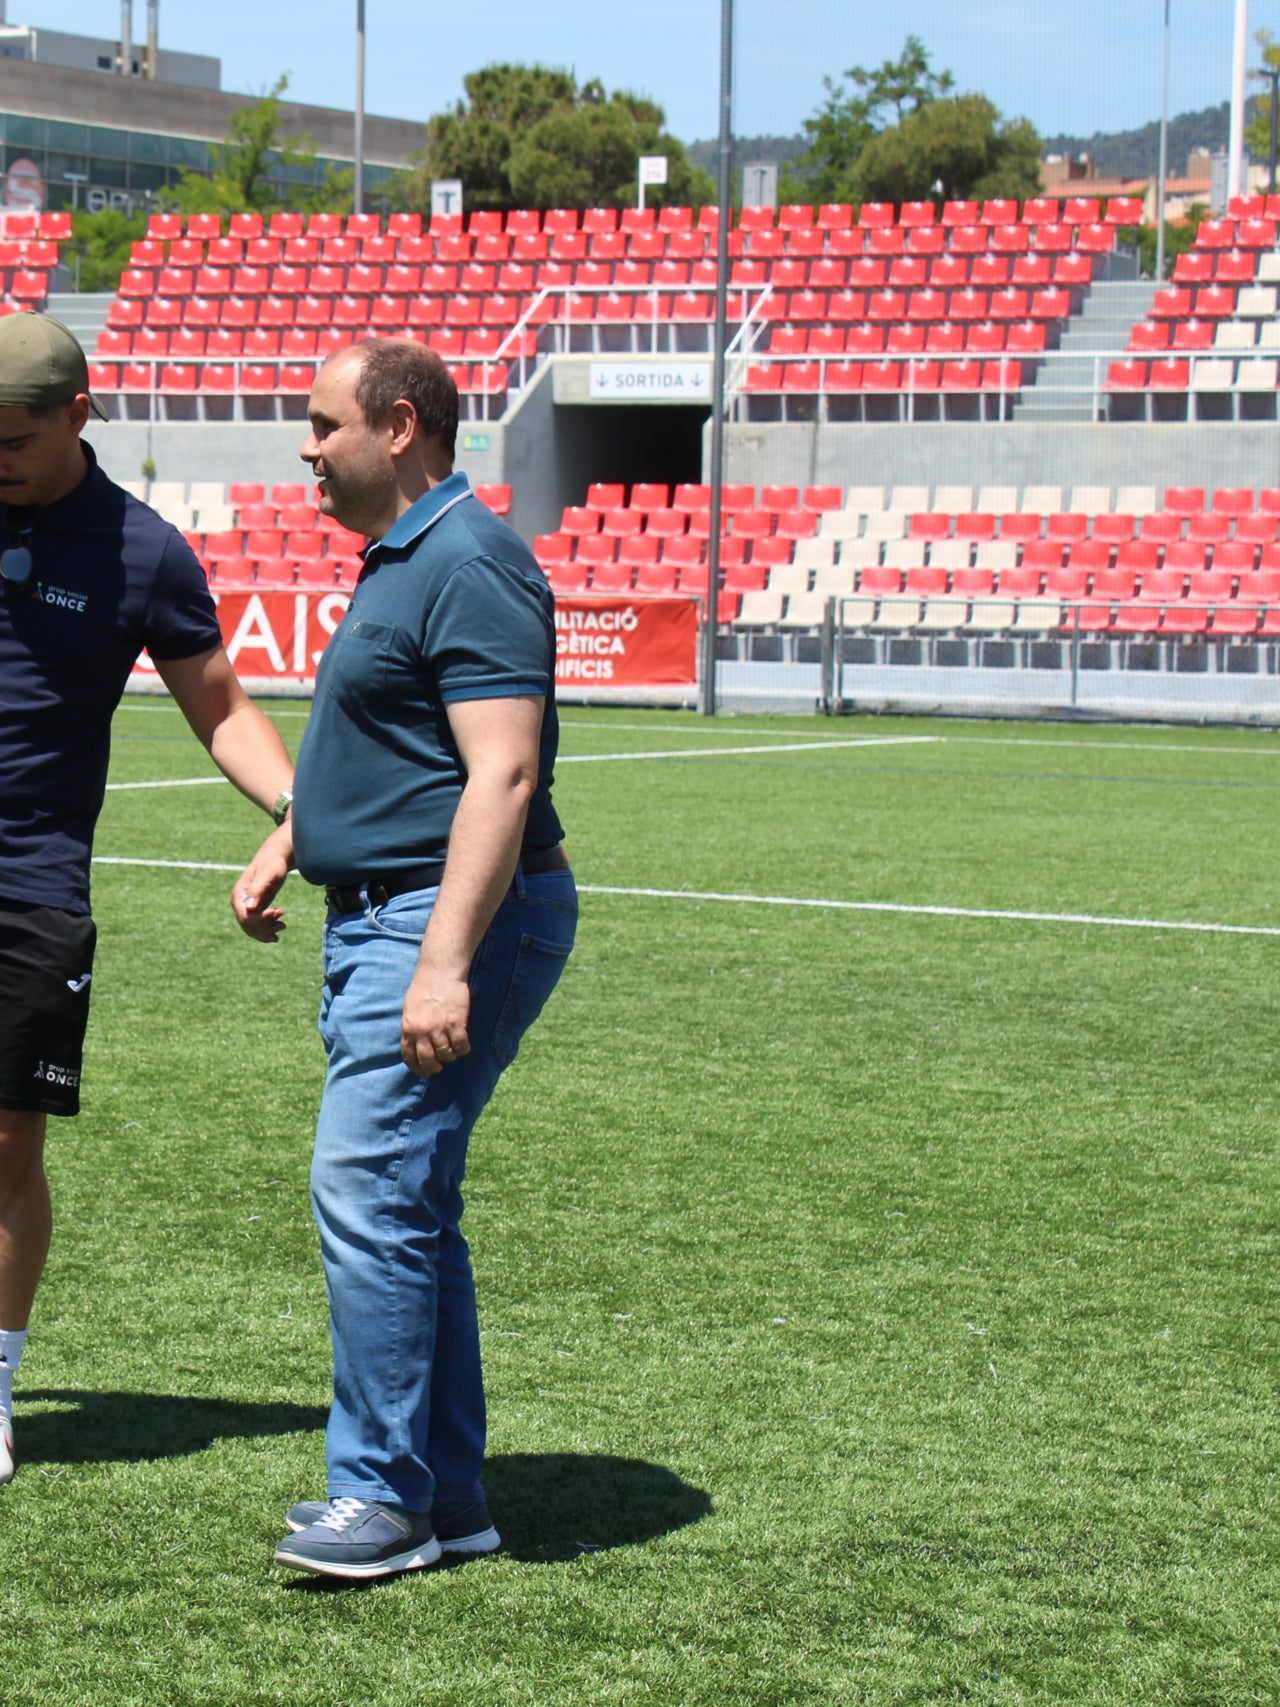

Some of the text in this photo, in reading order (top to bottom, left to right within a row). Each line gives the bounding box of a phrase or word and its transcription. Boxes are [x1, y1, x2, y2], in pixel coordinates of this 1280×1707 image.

[615, 372, 684, 388] SORTIDA
[45, 592, 87, 613] ONCE
[554, 606, 638, 632] ILITACIÓ
[217, 592, 354, 673] AIS
[555, 630, 625, 656] GÈTICA
[46, 1071, 78, 1087] ONCE
